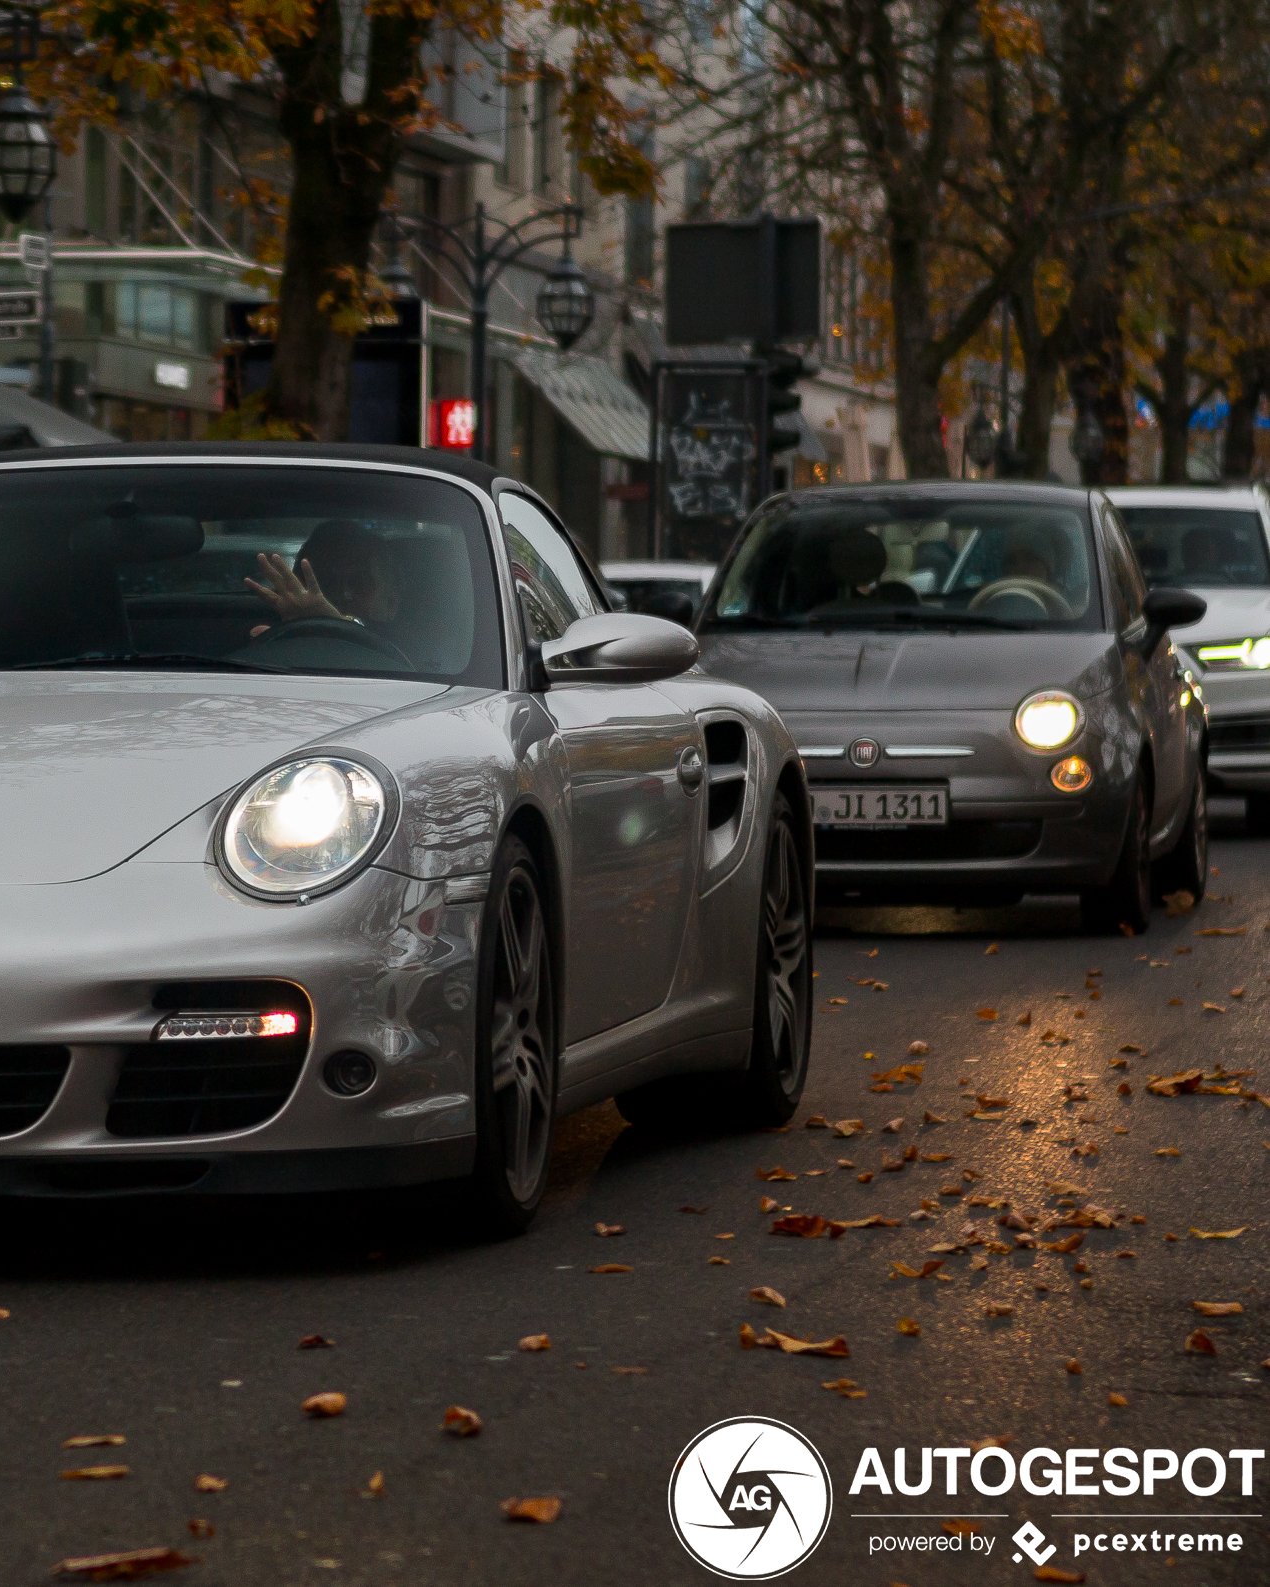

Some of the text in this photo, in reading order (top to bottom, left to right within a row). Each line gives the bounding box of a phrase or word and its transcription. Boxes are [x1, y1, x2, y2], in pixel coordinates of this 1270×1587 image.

[855, 746, 873, 760] FIAT
[834, 794, 866, 819] JI
[875, 794, 943, 819] 1311
